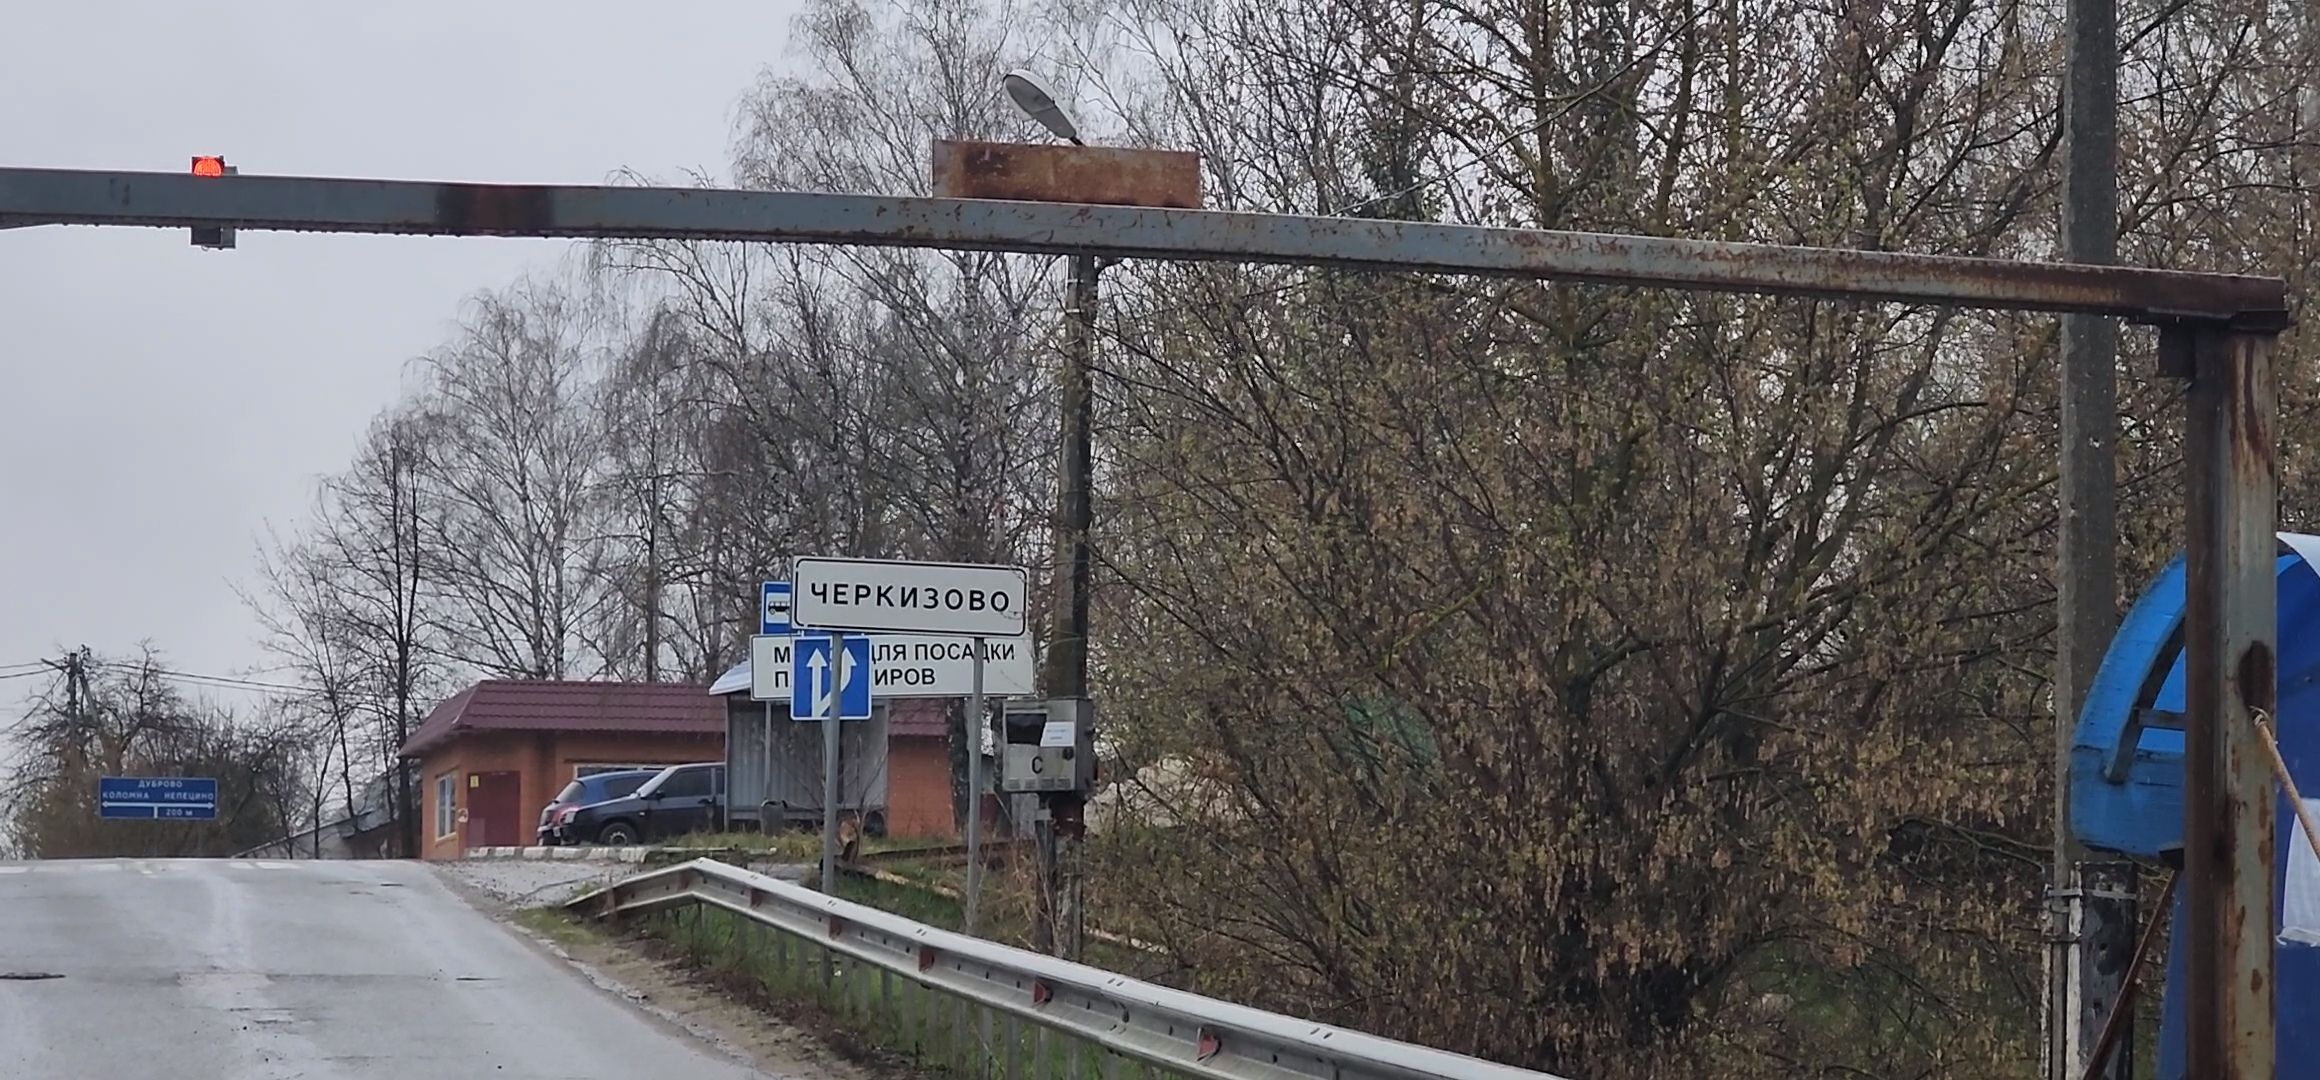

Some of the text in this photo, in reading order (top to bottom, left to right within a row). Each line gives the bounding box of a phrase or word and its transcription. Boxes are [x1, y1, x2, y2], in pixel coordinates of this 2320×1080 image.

[810, 582, 1010, 613] ЧЕРКИЗОВО
[138, 780, 183, 788] ДУБРОВО
[102, 791, 150, 799] КОЛОМНА
[164, 792, 215, 801] НЕПЕЦИНО
